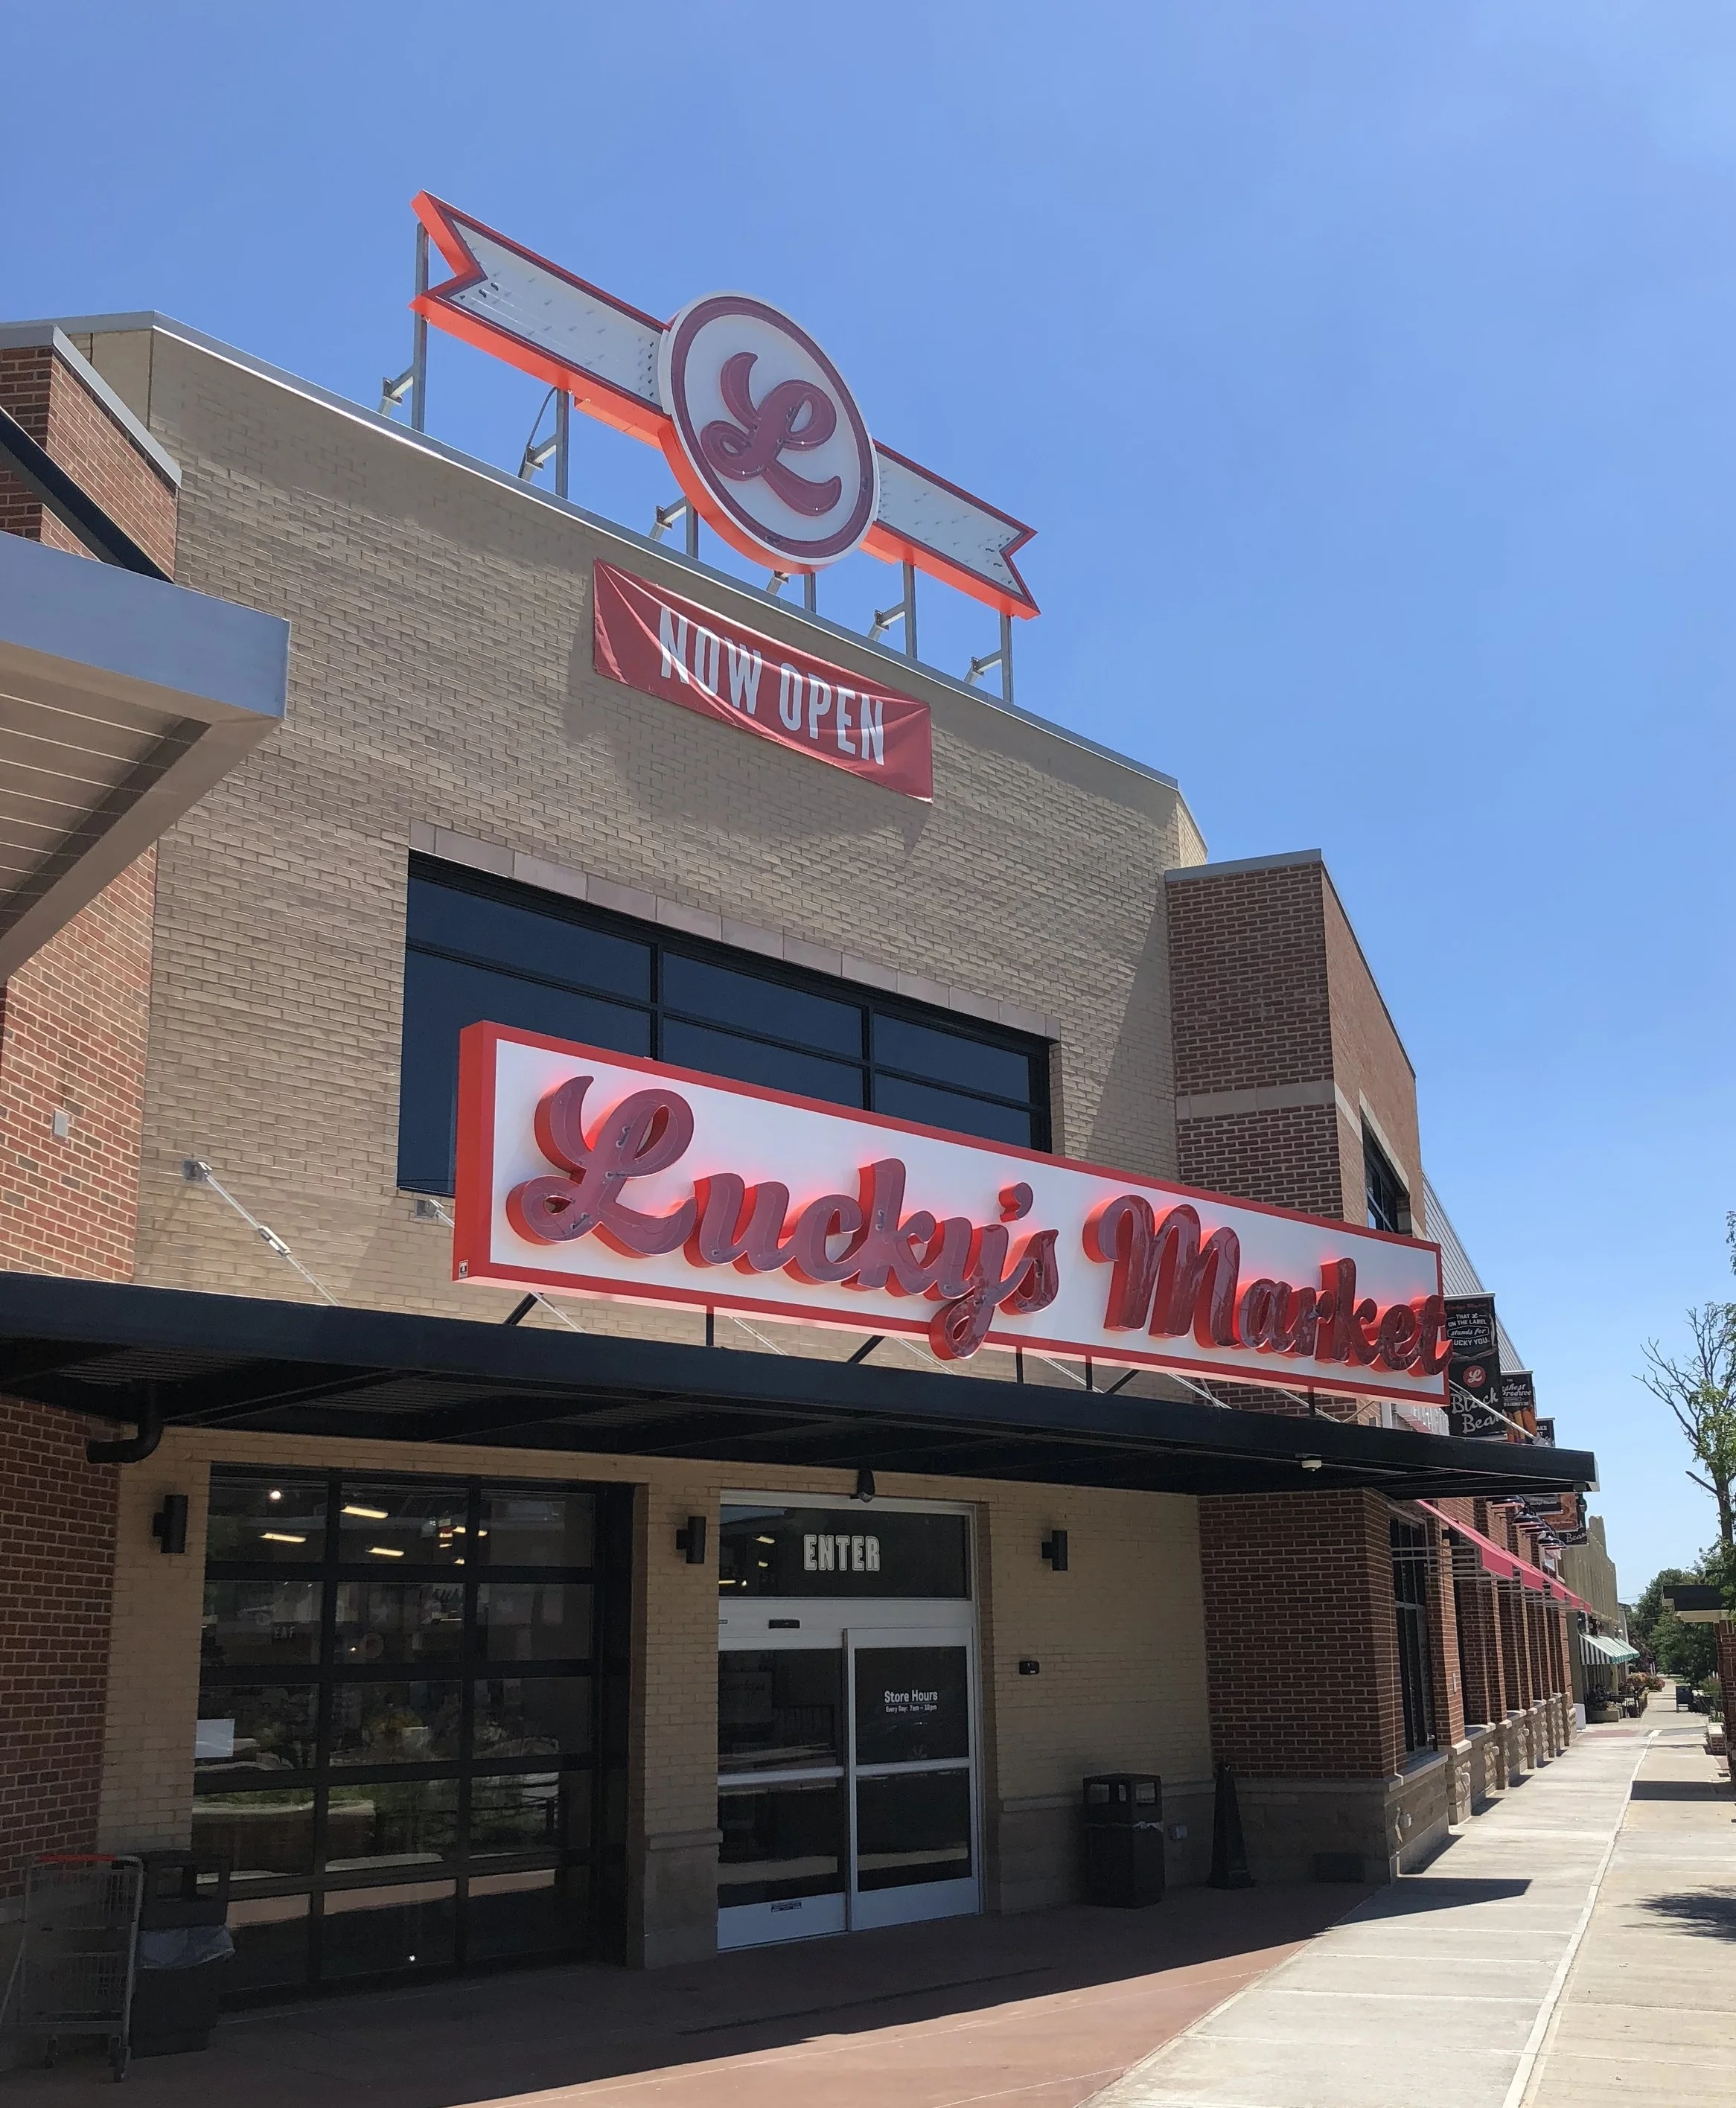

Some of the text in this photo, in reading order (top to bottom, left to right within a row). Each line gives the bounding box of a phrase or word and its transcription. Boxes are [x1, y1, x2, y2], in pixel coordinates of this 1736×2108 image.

[659, 607, 885, 766] NOW OPEN
[506, 1075, 1453, 1376] Lucky's Market
[1450, 1327, 1487, 1336] stands for
[1473, 1337, 1490, 1345] YOU.
[804, 1534, 880, 1571] ENTER
[884, 1689, 938, 1703] Store Hours
[886, 1705, 898, 1713] Every
